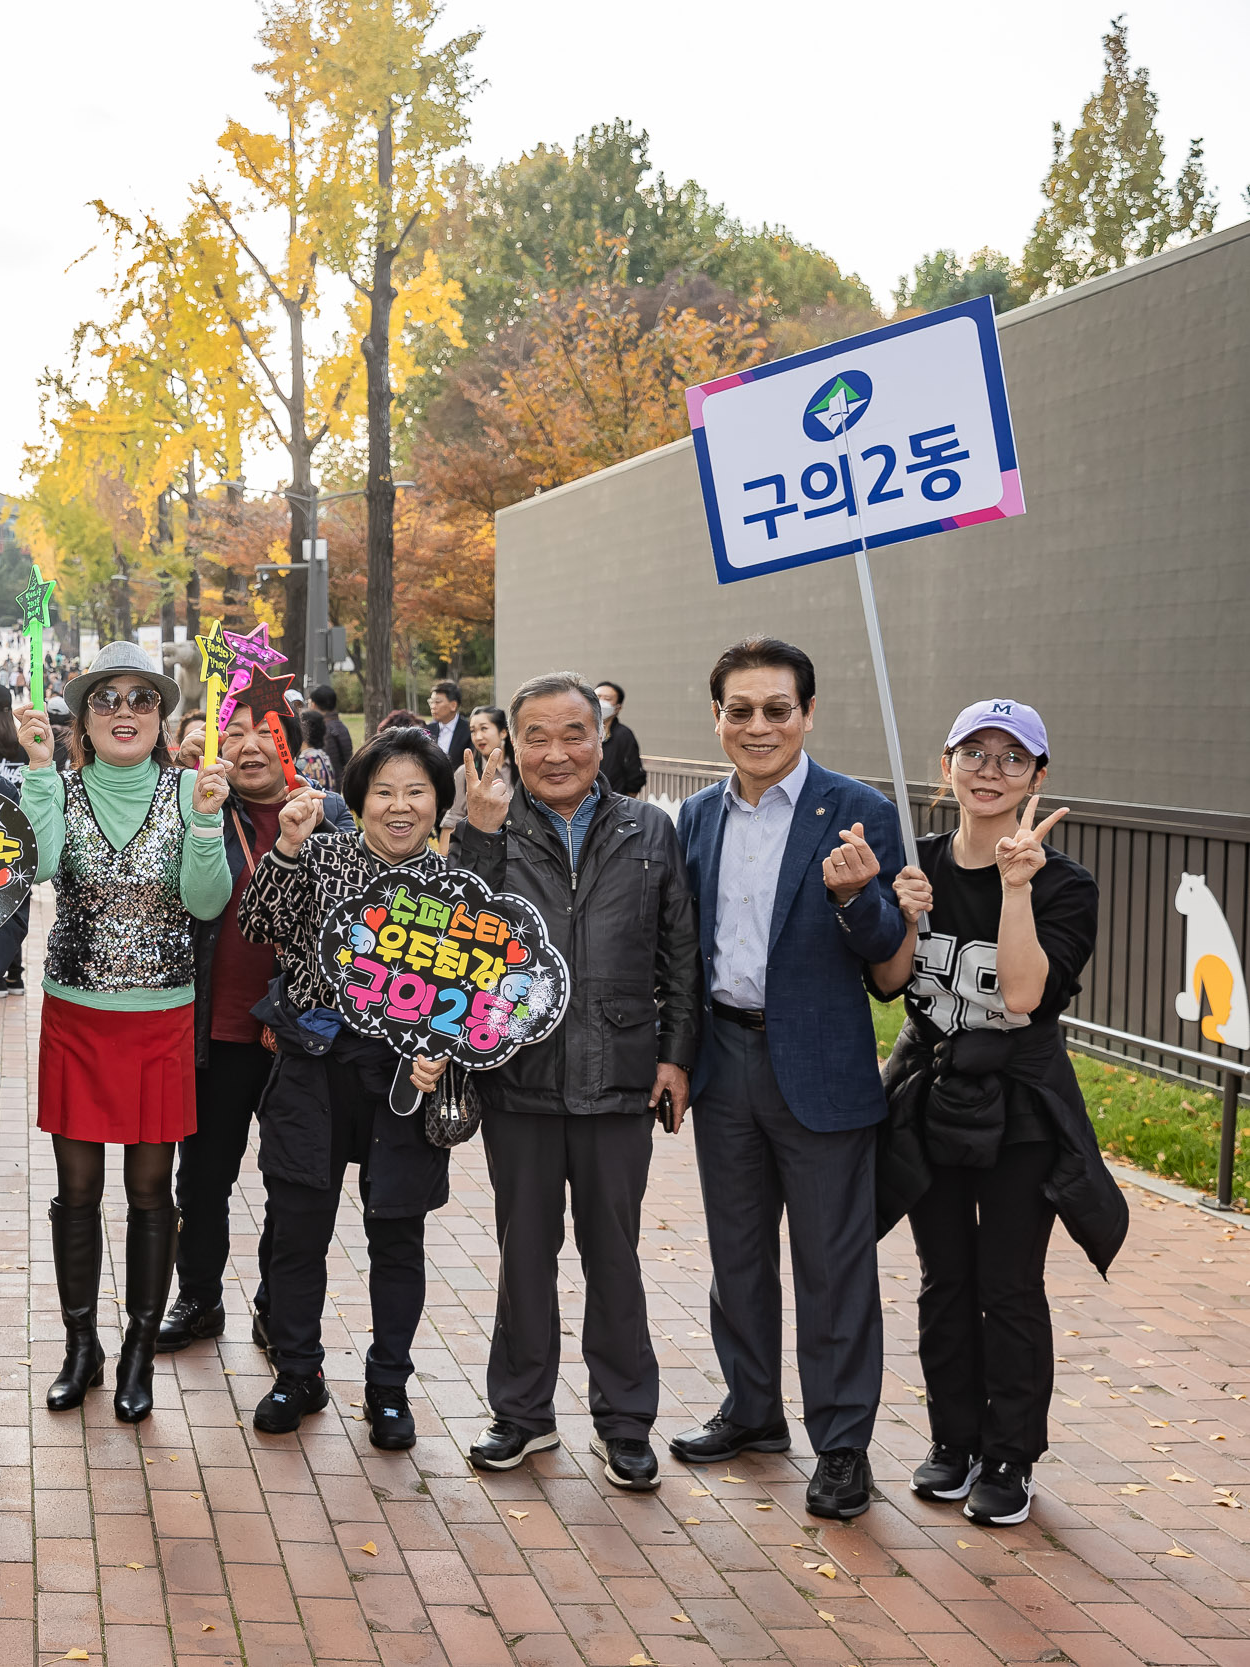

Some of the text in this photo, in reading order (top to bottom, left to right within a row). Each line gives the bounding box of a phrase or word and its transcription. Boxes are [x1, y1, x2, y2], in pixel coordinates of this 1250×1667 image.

[743, 424, 970, 540] 구의2동
[991, 703, 1012, 716] M
[390, 887, 510, 945] 슈퍼스타
[375, 924, 506, 991] 우주최강
[347, 956, 514, 1050] 구의2동
